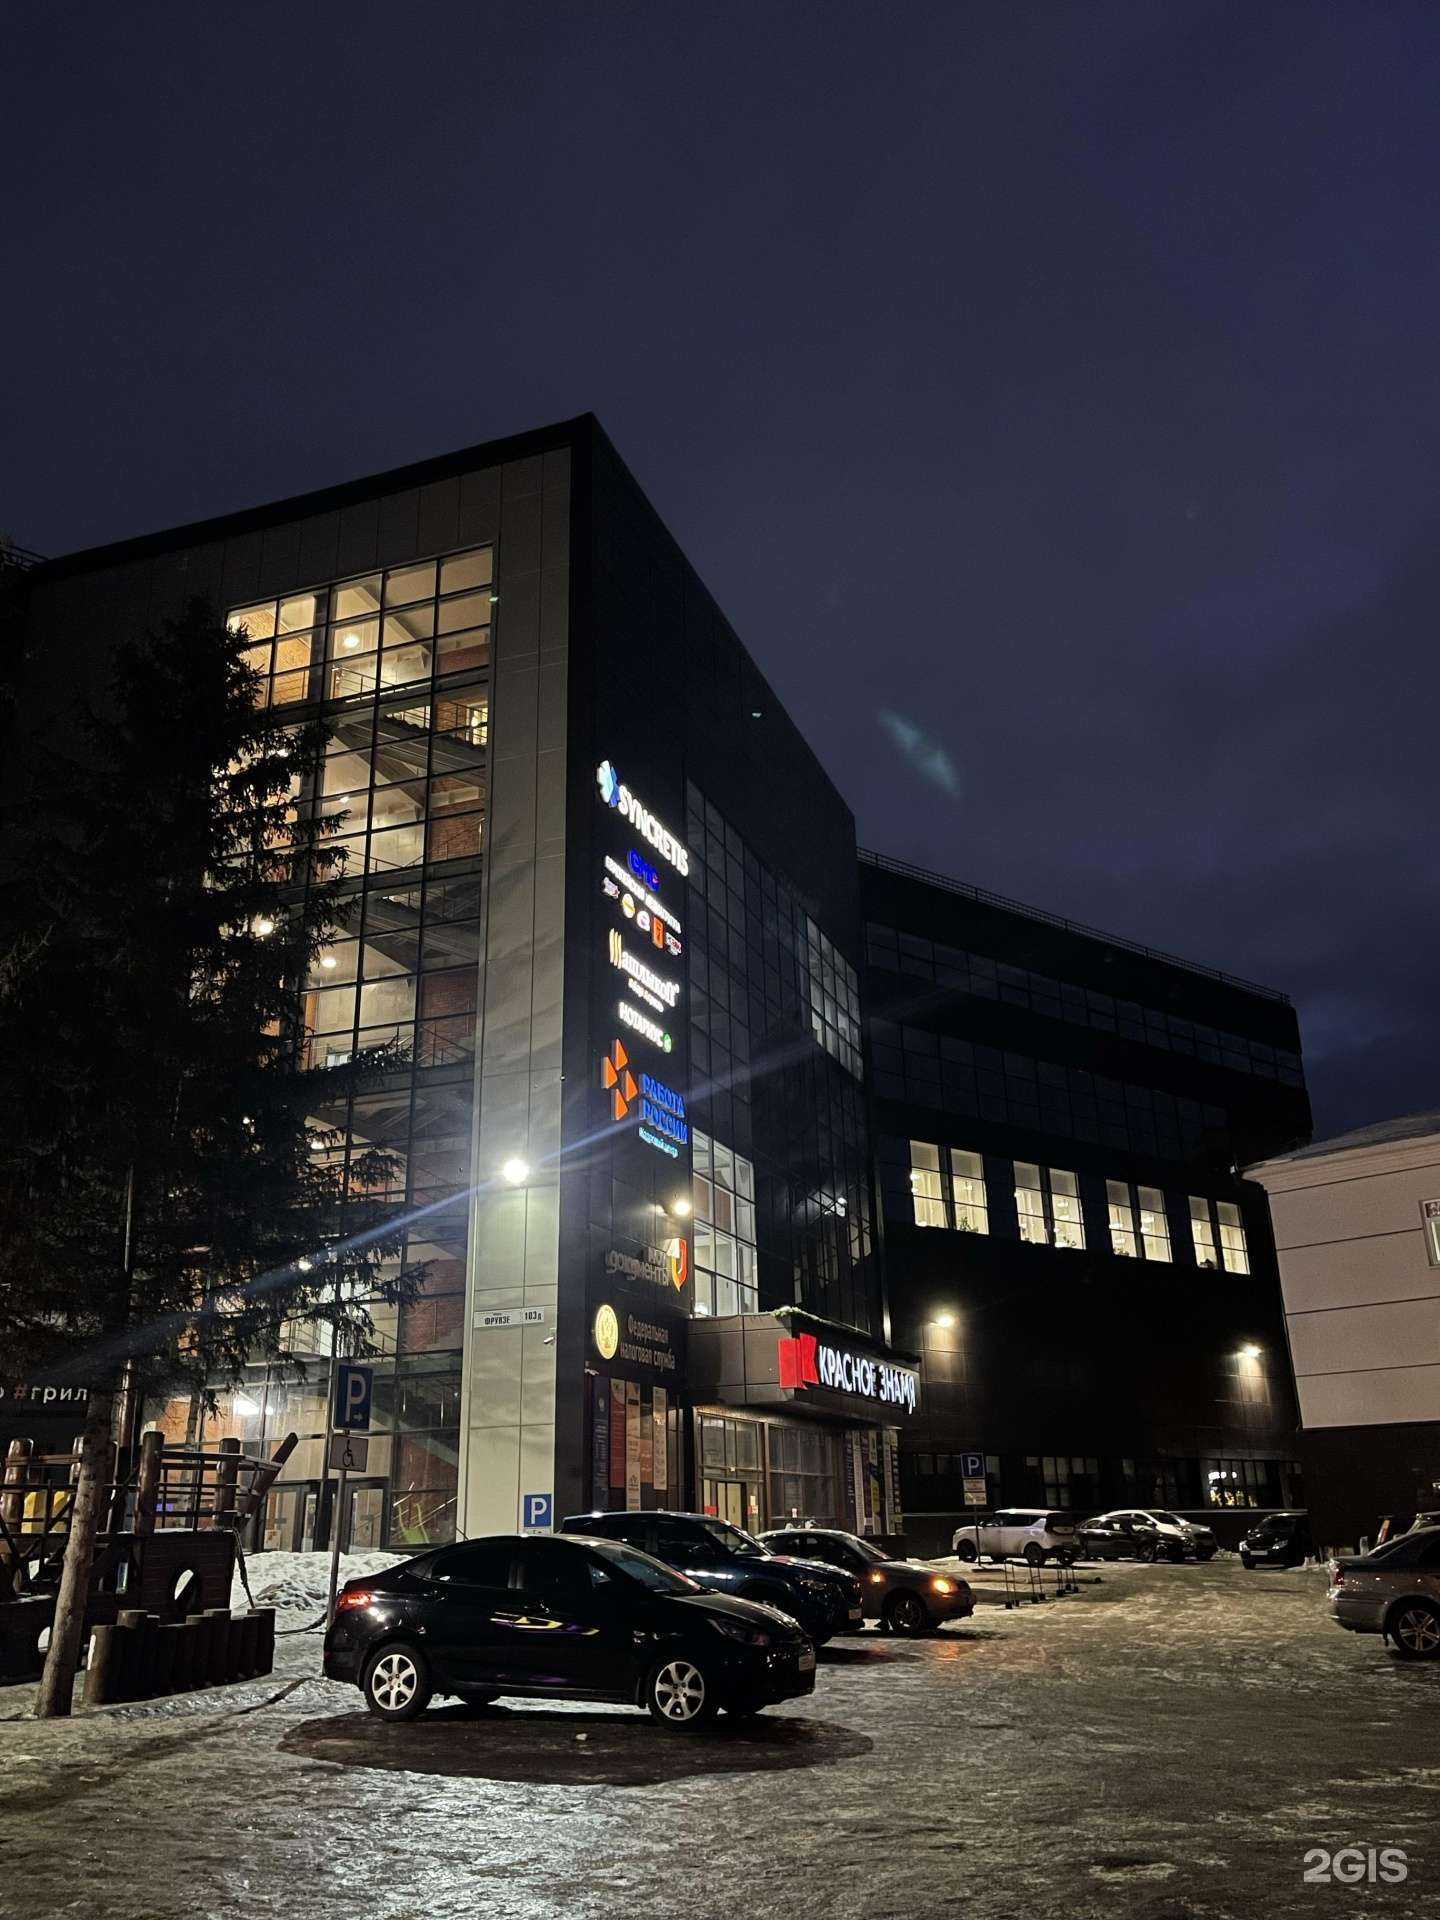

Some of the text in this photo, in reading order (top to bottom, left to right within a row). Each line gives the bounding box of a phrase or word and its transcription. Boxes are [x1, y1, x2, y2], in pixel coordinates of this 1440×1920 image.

[641, 1072, 686, 1119] РАБОТА
[641, 1097, 689, 1145] РОССИИ
[484, 1316, 511, 1325] ФРУНЗЕ
[14, 1384, 89, 1404] #грил
[818, 1345, 916, 1415] КРАСНОЕ ЗНАМЯ
